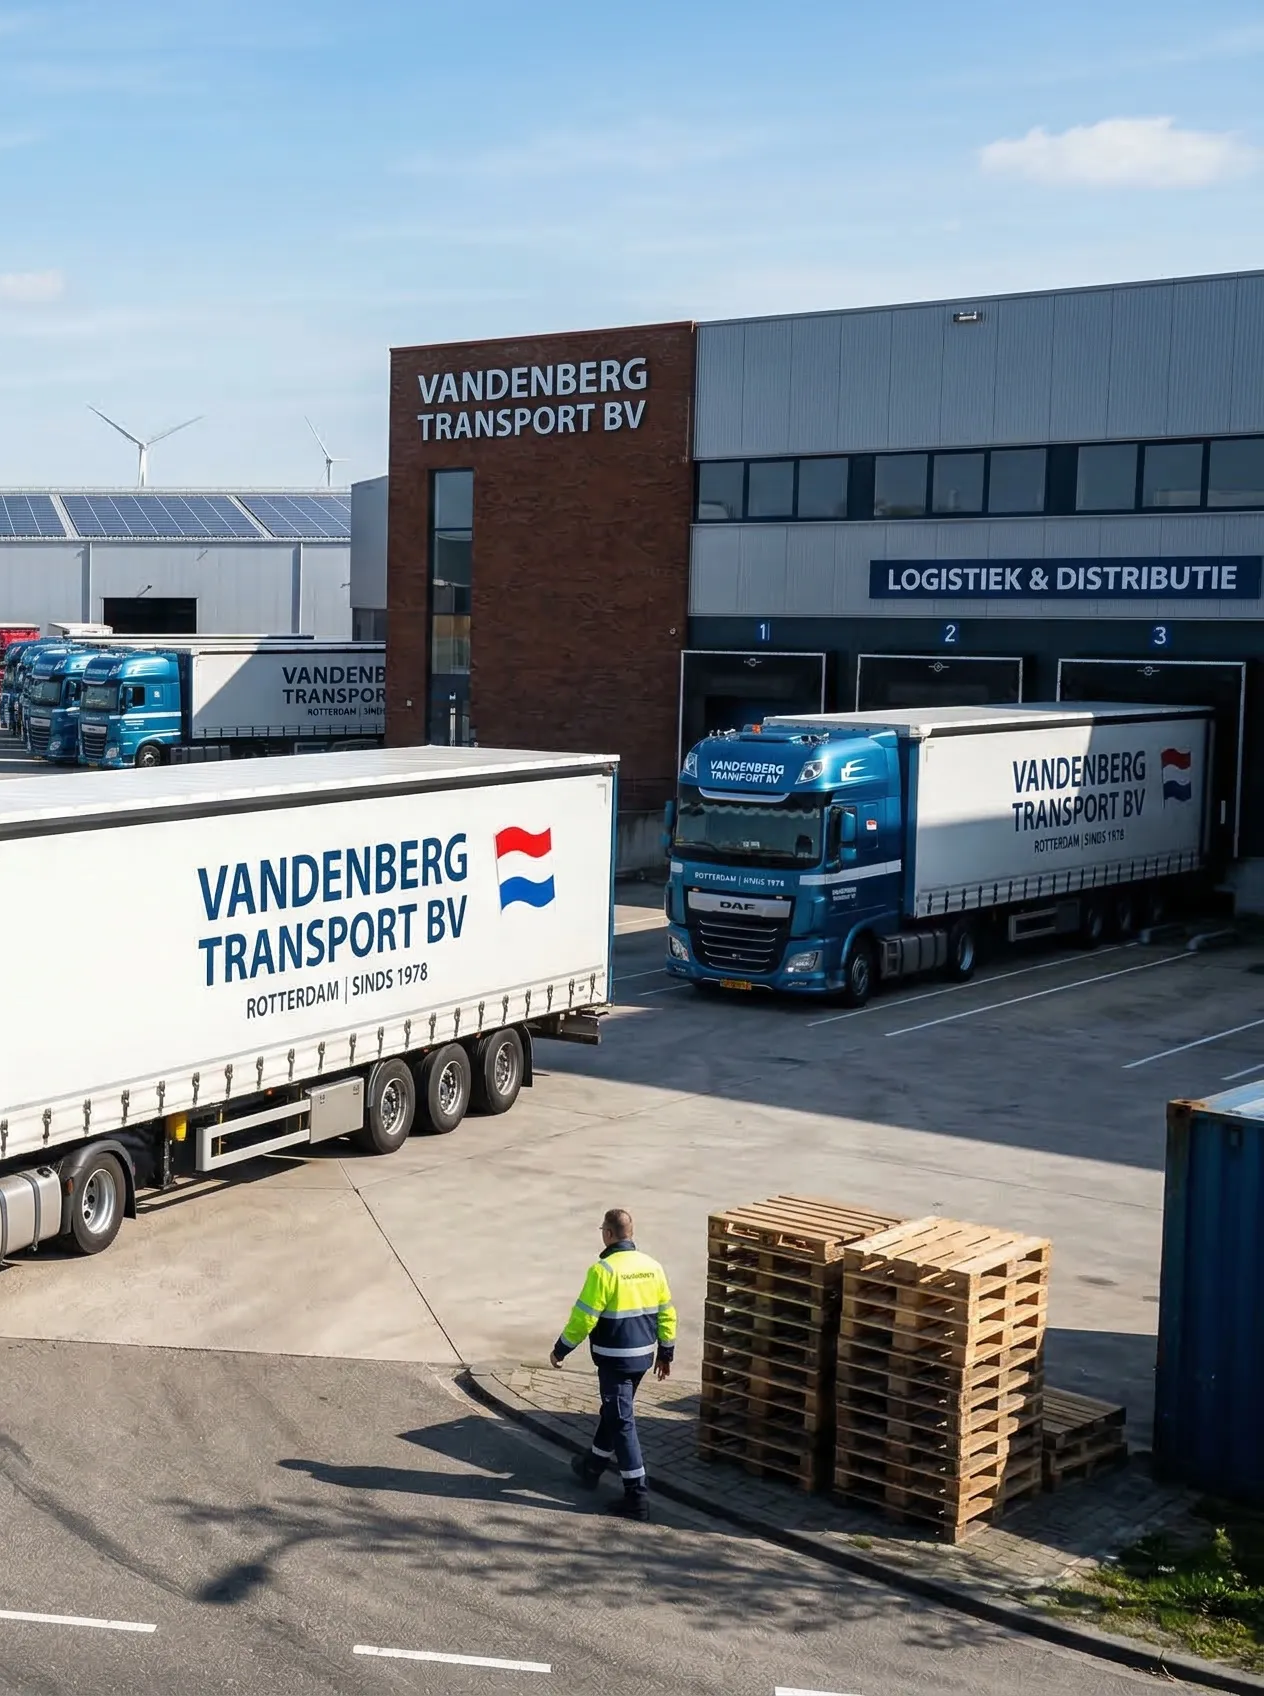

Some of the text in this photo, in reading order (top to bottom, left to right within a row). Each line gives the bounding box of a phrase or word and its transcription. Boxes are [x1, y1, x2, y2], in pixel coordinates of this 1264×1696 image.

[417, 357, 647, 405] VANDENBERG
[417, 400, 646, 441] TRANSPORT BV
[888, 565, 1238, 591] LOGISTIEK & DISTRIBUTIE
[759, 623, 766, 640] 1
[944, 624, 956, 642] 2
[1154, 626, 1167, 645] 3
[281, 666, 386, 685] VANDENB
[282, 687, 386, 704] TRANSPOR
[307, 707, 357, 716] ROTTERDAM
[710, 760, 785, 775] VANDENBERG
[1012, 750, 1146, 793] VANDENBERG
[1012, 788, 1146, 832] TRANSPORT BV
[1034, 834, 1080, 853] ROTTERDAM
[197, 832, 468, 921] VANDENBERG
[719, 901, 756, 911] DAF
[198, 894, 467, 987] TRANSPORT BV
[246, 981, 340, 1020] ROTTERDAM
[352, 968, 394, 997] SINDS
[396, 962, 429, 987] 1978
